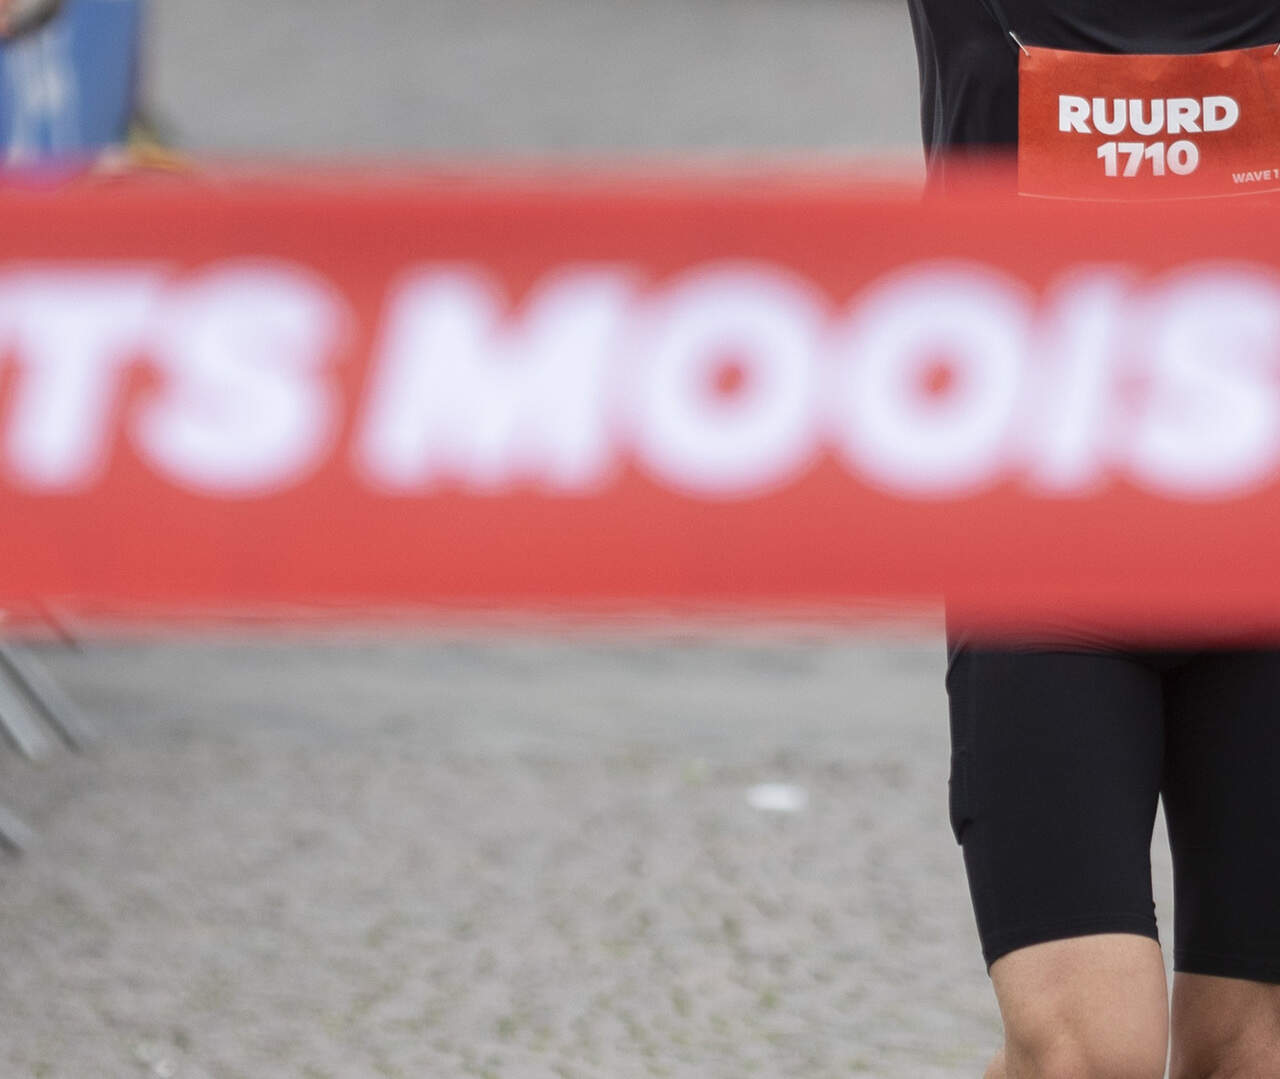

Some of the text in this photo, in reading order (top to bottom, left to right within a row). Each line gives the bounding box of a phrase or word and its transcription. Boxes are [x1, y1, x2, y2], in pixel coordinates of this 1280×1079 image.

[1058, 94, 1239, 136] RUURD
[1096, 139, 1199, 177] 1710
[1232, 170, 1271, 184] WAVE
